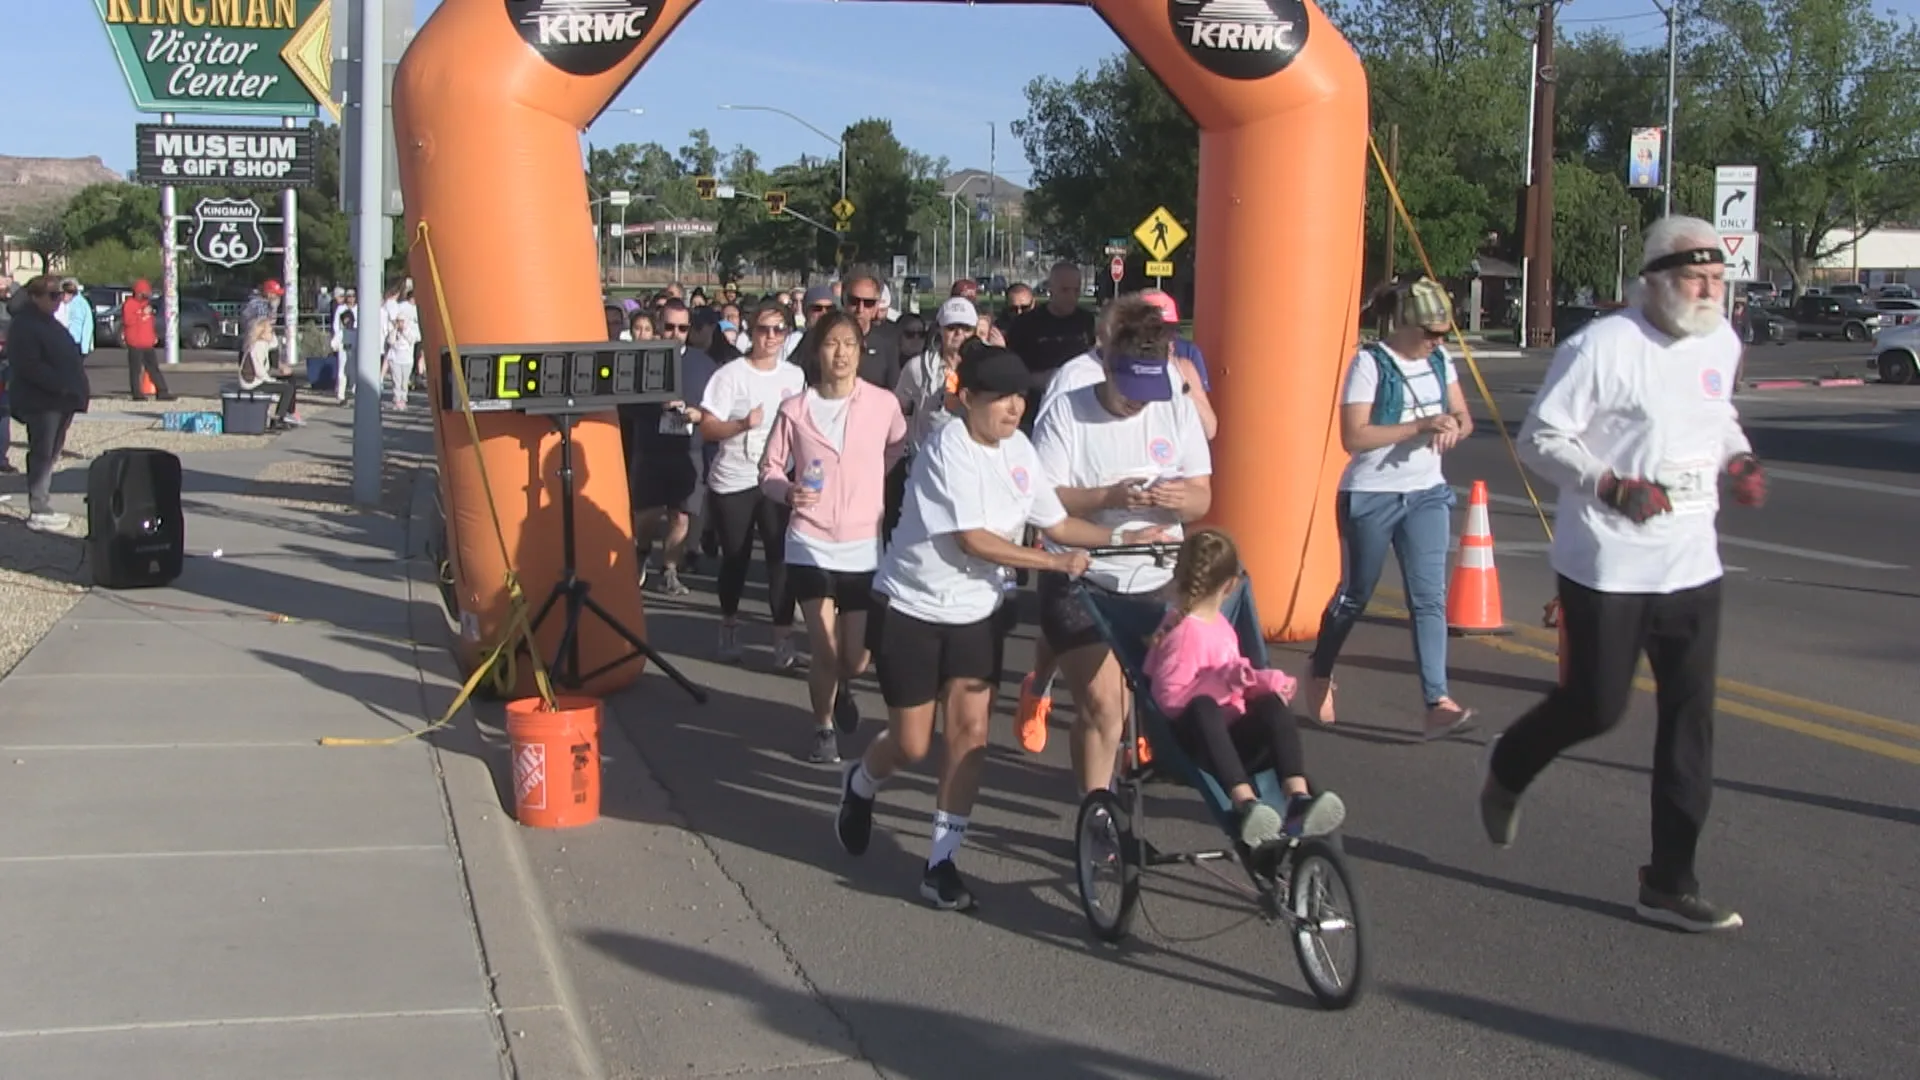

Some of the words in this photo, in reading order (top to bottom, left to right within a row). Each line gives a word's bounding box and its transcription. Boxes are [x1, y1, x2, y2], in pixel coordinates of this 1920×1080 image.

[106, 0, 297, 28] KINGMAN
[538, 10, 647, 45] KRMC
[1191, 21, 1294, 50] KRMC
[146, 29, 258, 65] Visitor
[168, 63, 278, 98] Center
[154, 133, 297, 160] MUSEUM
[161, 159, 178, 175] &
[183, 160, 229, 176] GIFT
[232, 161, 291, 177] SHOP
[203, 206, 253, 217] KINGMAN
[1720, 219, 1747, 228] ONLY
[219, 222, 238, 233] AZ
[664, 224, 713, 232] KINGMAN
[208, 234, 248, 259] 66
